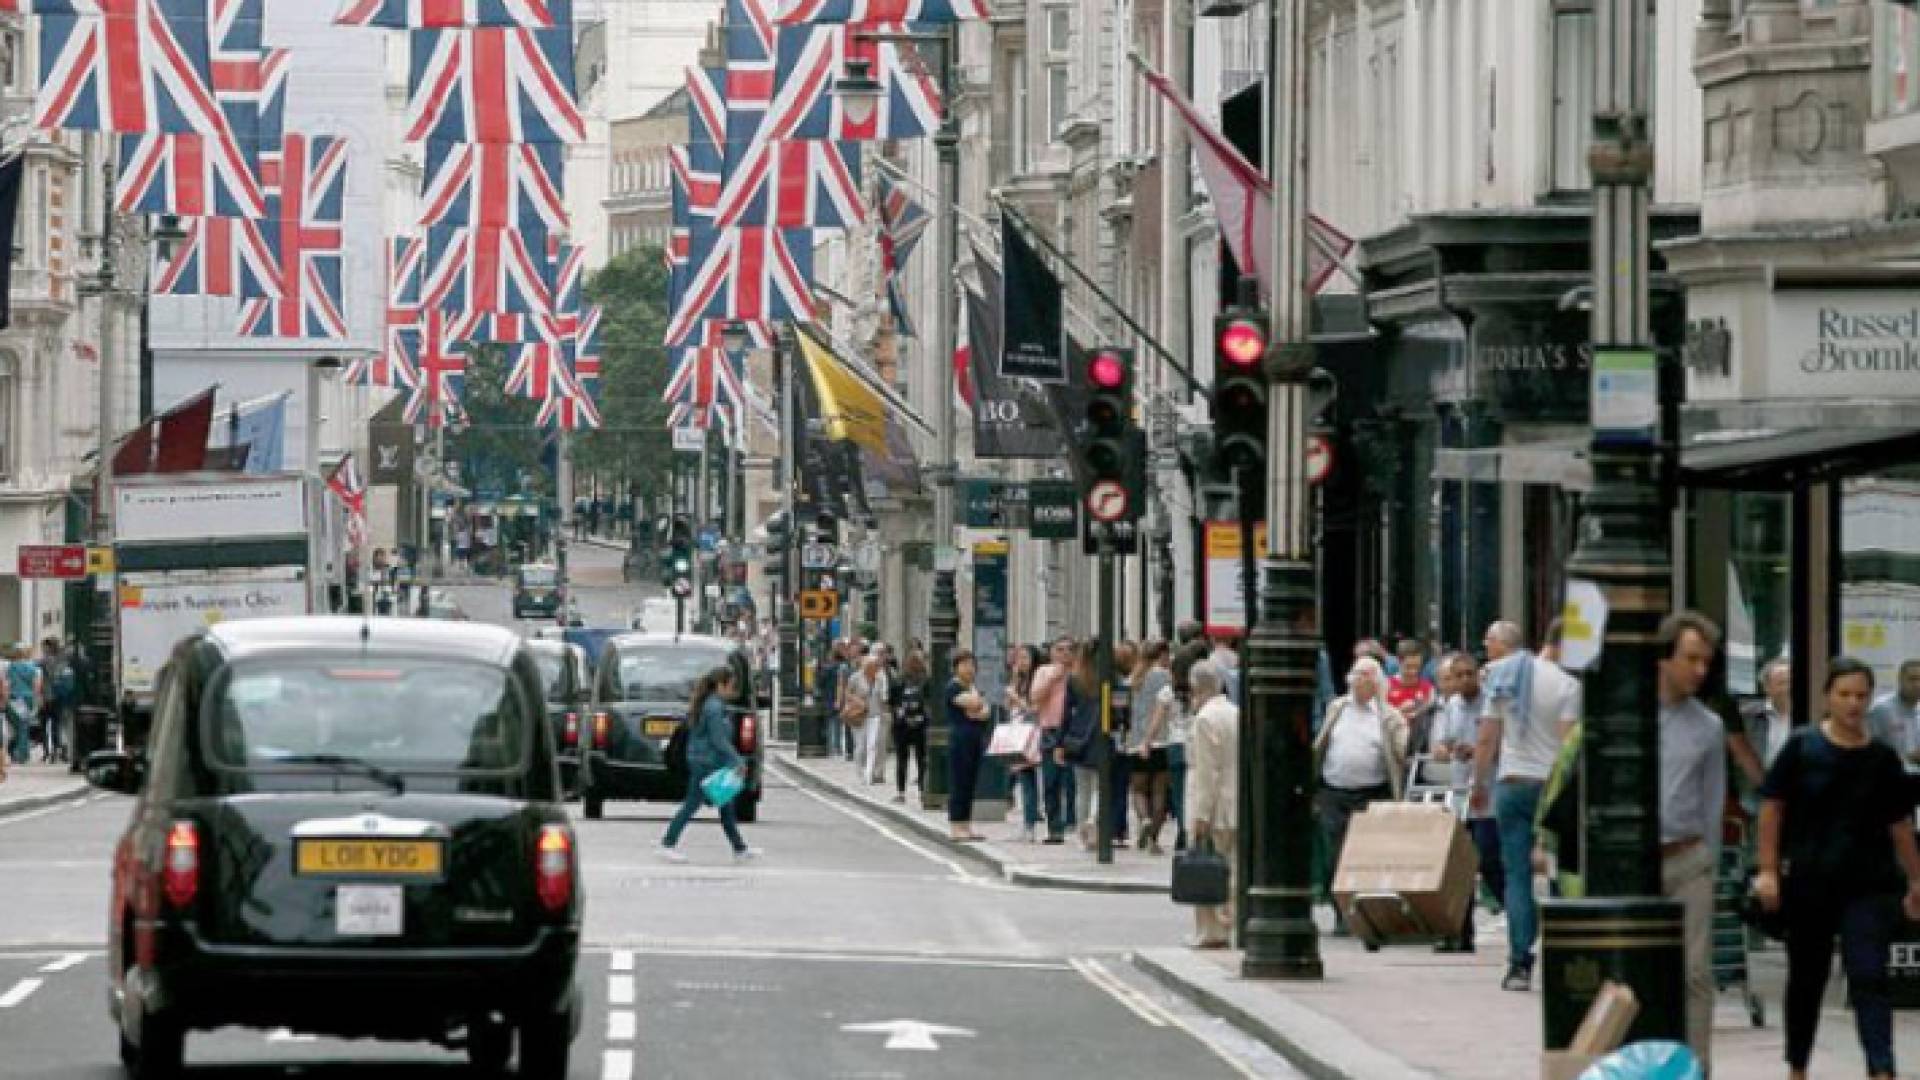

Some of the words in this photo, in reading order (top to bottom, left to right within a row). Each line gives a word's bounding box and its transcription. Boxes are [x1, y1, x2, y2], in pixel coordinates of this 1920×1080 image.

[1819, 306, 1919, 338] Russel
[1576, 342, 1589, 368] S
[1799, 341, 1920, 373] Bromle
